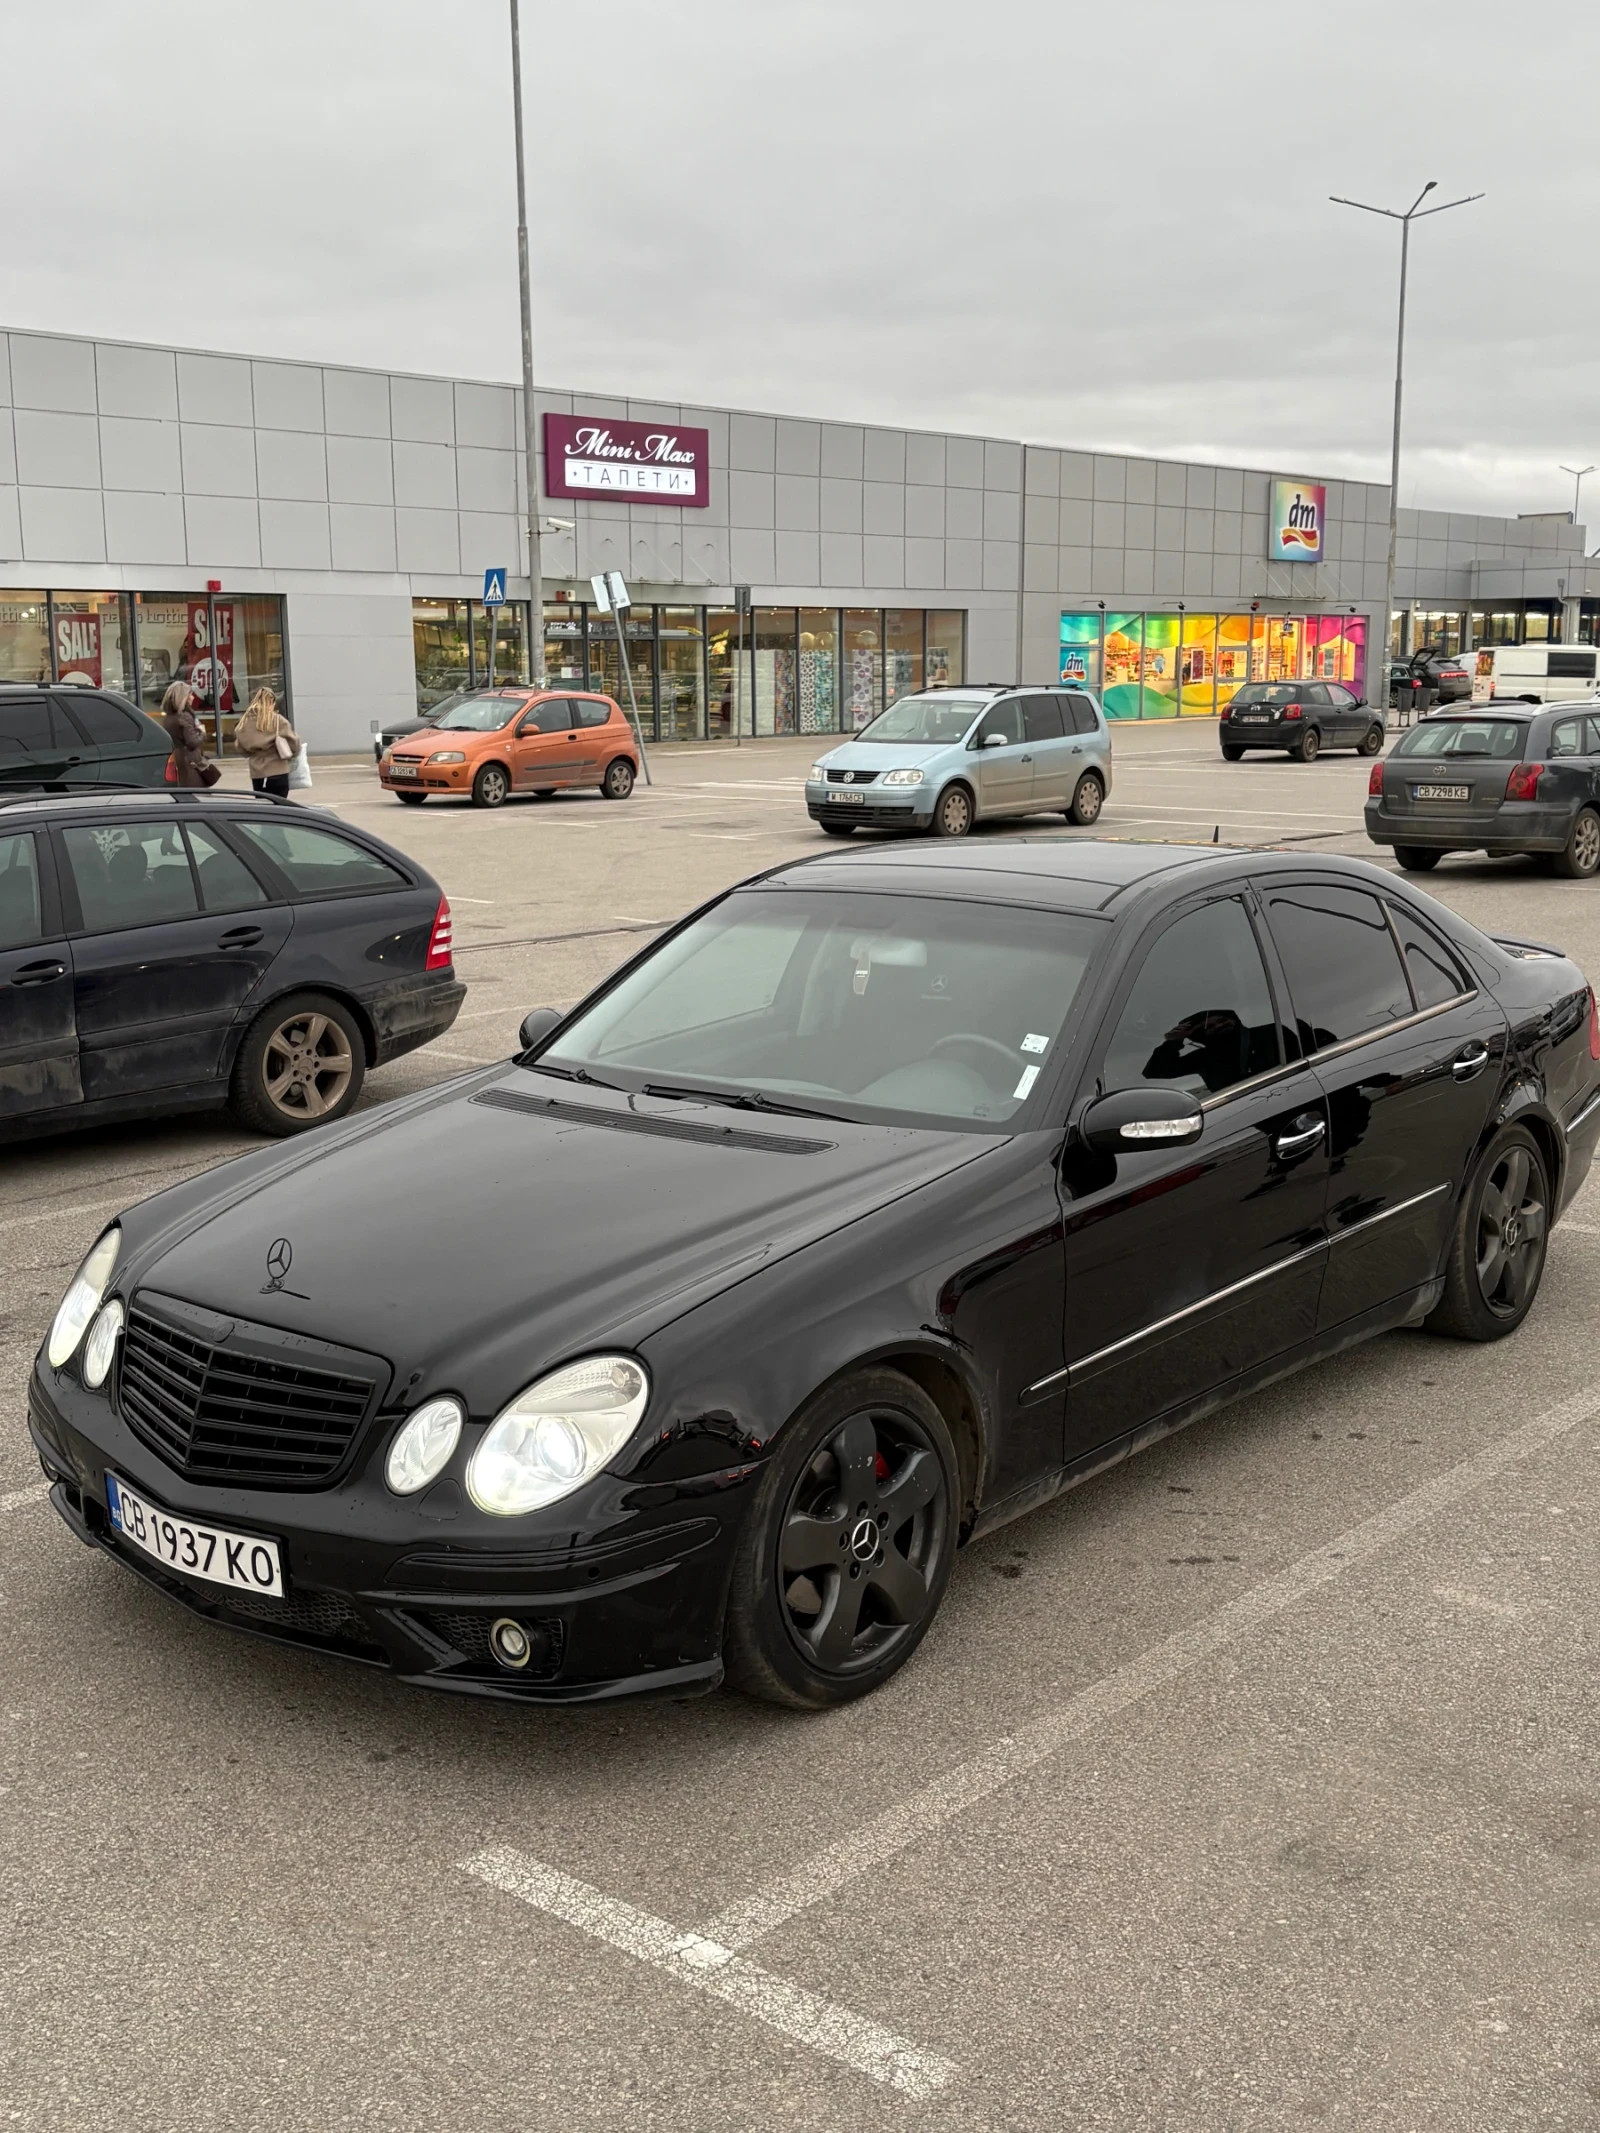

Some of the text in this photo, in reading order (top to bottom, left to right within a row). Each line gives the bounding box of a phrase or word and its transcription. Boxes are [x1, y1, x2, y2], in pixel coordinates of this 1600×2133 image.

[564, 427, 696, 463] Mini Max
[583, 466, 680, 489] ТАПЕТИ
[1289, 493, 1316, 529] dm
[58, 619, 99, 662] SALE
[1066, 653, 1084, 671] dm
[1418, 786, 1467, 798] CB 7298 KE
[112, 1506, 122, 1522] BG
[121, 1491, 274, 1587] CB 1937 KO
